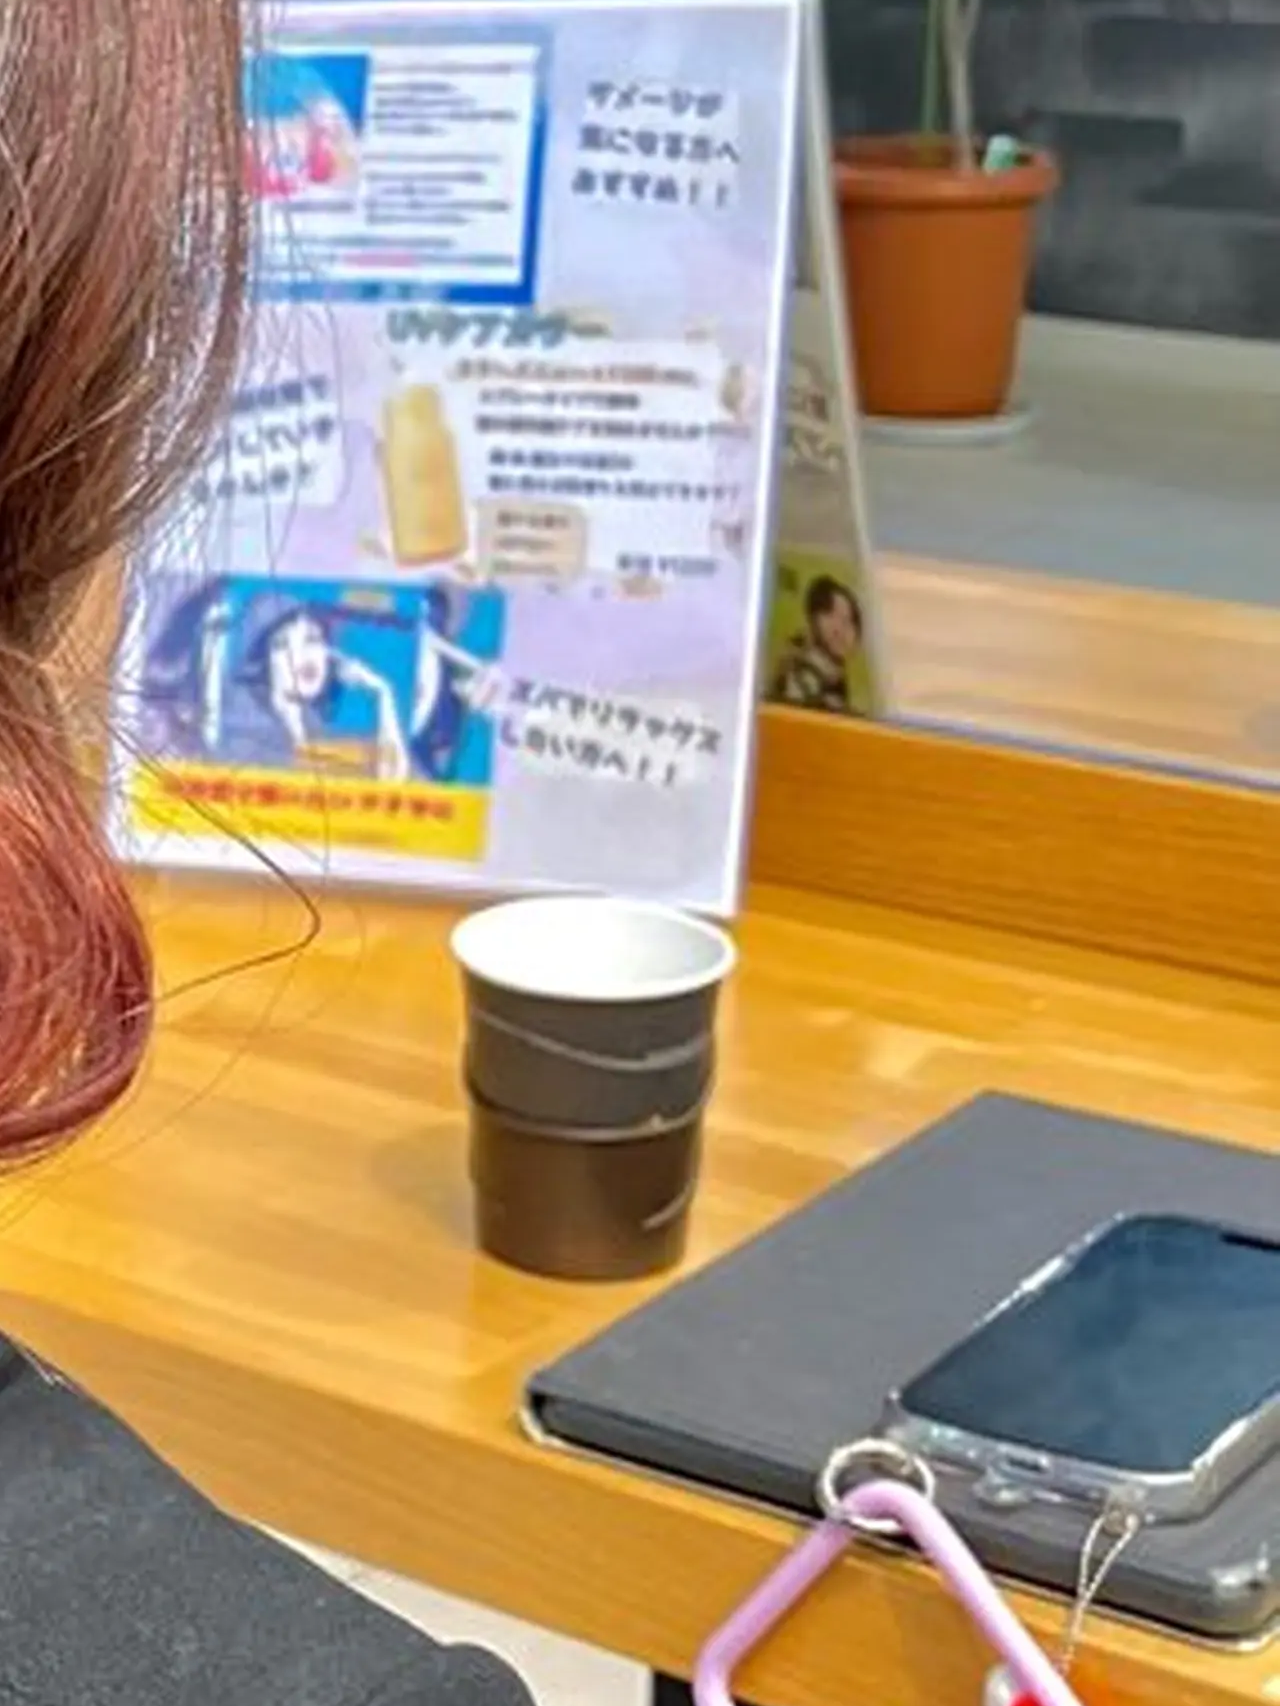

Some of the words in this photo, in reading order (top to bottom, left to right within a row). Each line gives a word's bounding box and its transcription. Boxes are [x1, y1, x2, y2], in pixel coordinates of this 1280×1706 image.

[579, 124, 741, 164] 気になる方へ
